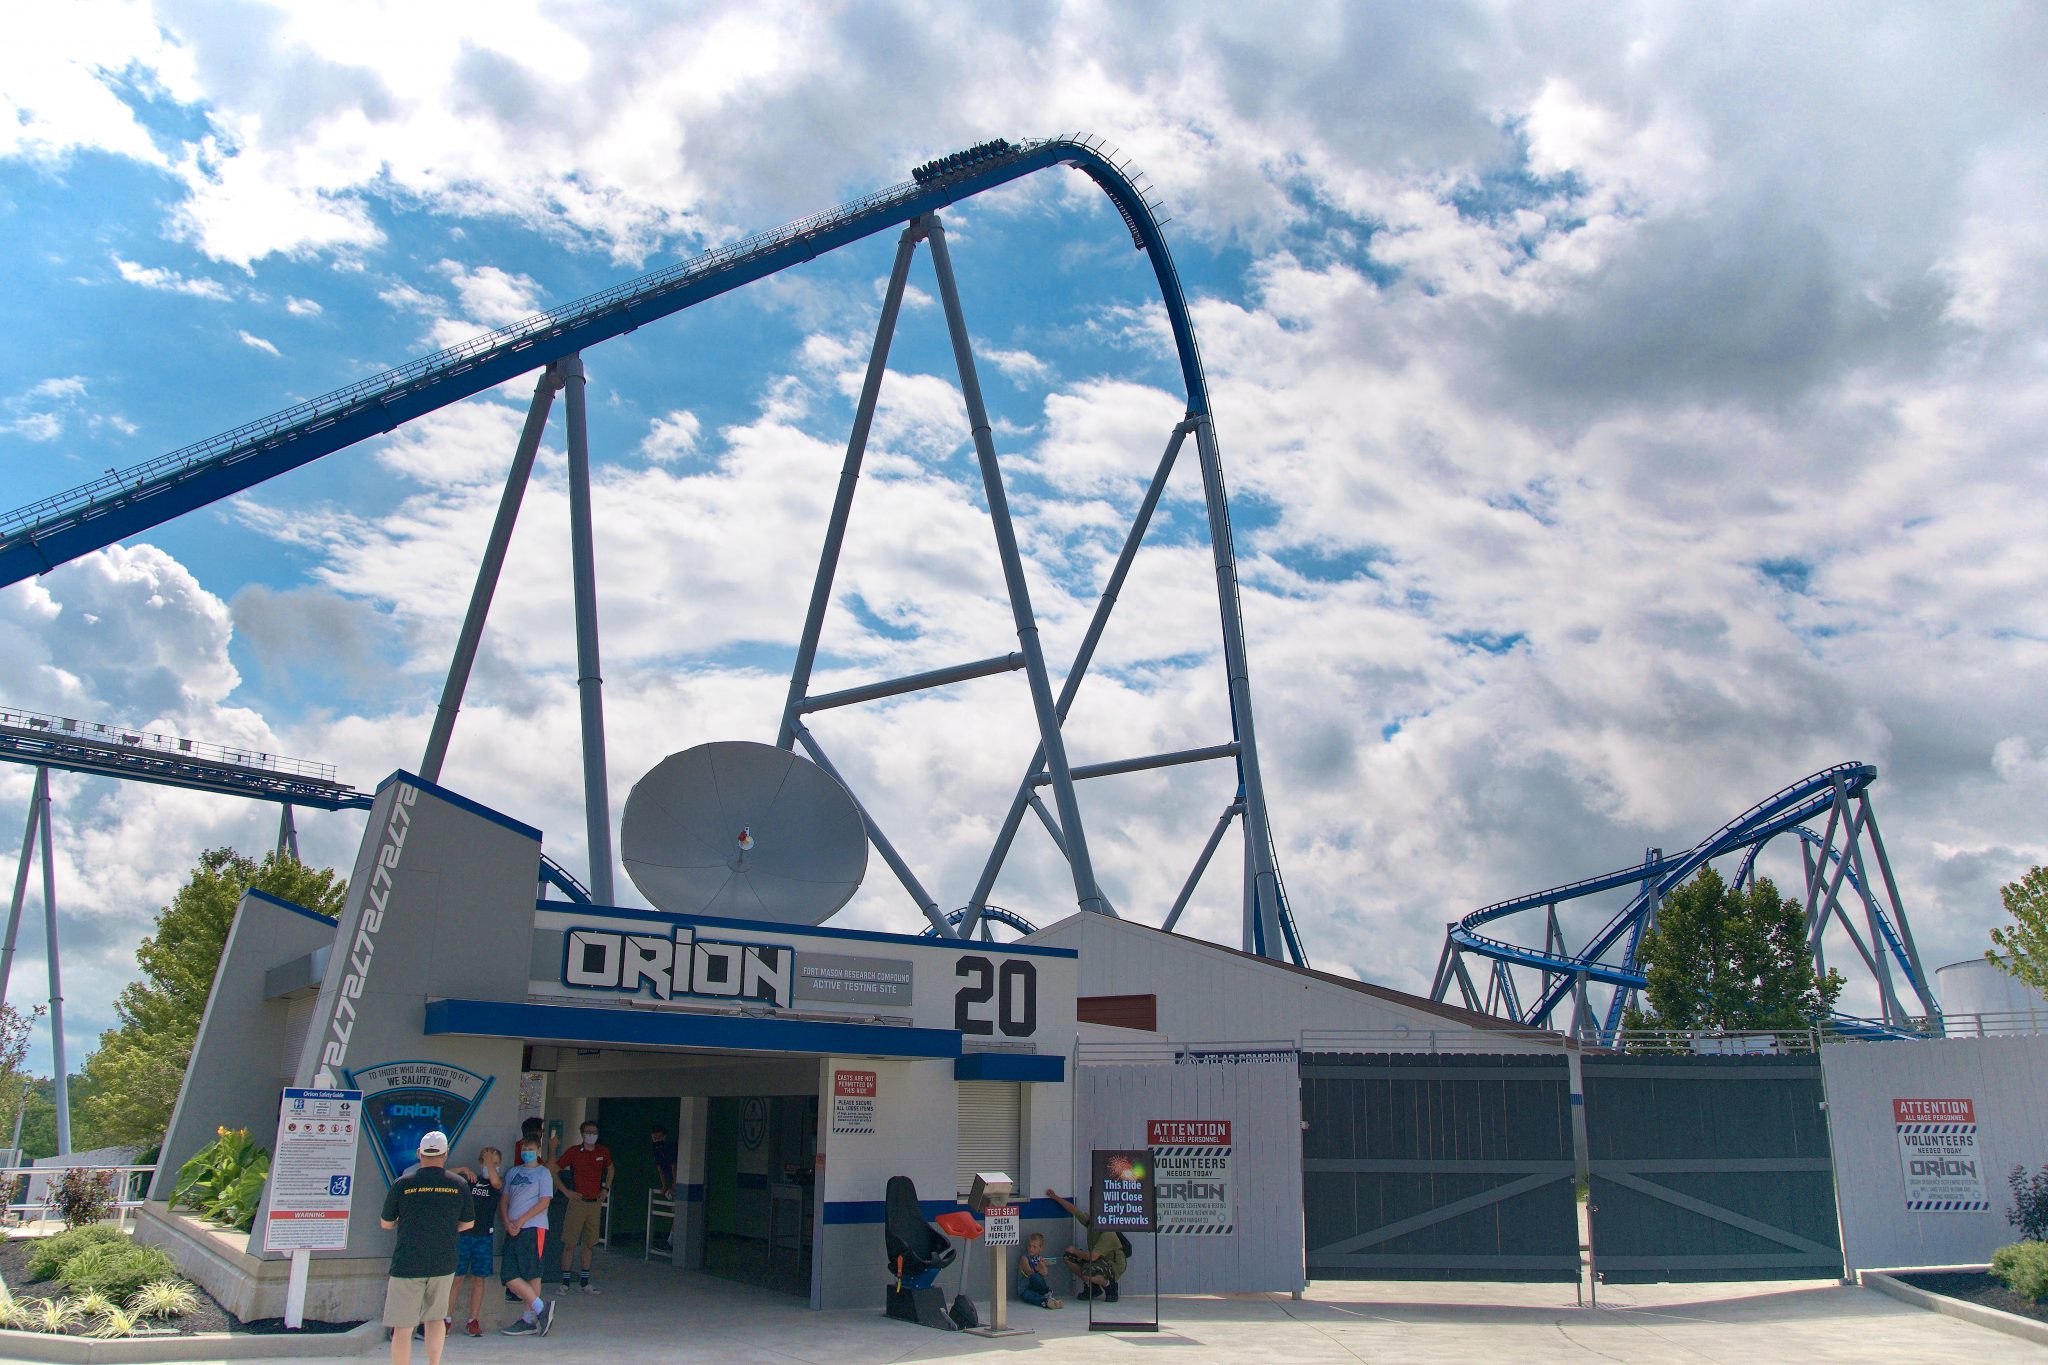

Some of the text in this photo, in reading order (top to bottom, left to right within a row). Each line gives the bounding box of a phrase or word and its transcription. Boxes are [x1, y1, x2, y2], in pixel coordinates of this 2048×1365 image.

[803, 966, 910, 983] FORT MASON RESEARCH COMPOUND
[812, 980, 897, 994] ACTIVE TESTING SITE
[955, 955, 1036, 1037] 20
[368, 1072, 377, 1080] TO
[378, 1067, 398, 1078] THOSE
[400, 1066, 414, 1074] WHO
[415, 1066, 427, 1074] ARE
[428, 1067, 448, 1077] ABOUT
[450, 1070, 458, 1080] TO
[387, 1075, 452, 1088] WE SALUTE YOU!
[1901, 1101, 1969, 1114] ATTENTION
[1154, 1123, 1226, 1136] ATTENTION
[1904, 1136, 1974, 1146] VOLUNTEERS
[1154, 1158, 1226, 1169] VOLUNTEERS
[1104, 1180, 1142, 1190] This Ride
[472, 1187, 490, 1197] BSBL
[1103, 1191, 1142, 1201] Will Close
[987, 1207, 1017, 1216] TEST SEAT
[1104, 1202, 1142, 1215] Early Due
[1098, 1214, 1149, 1225] to Fireworks
[1004, 1224, 1014, 1232] FOR
